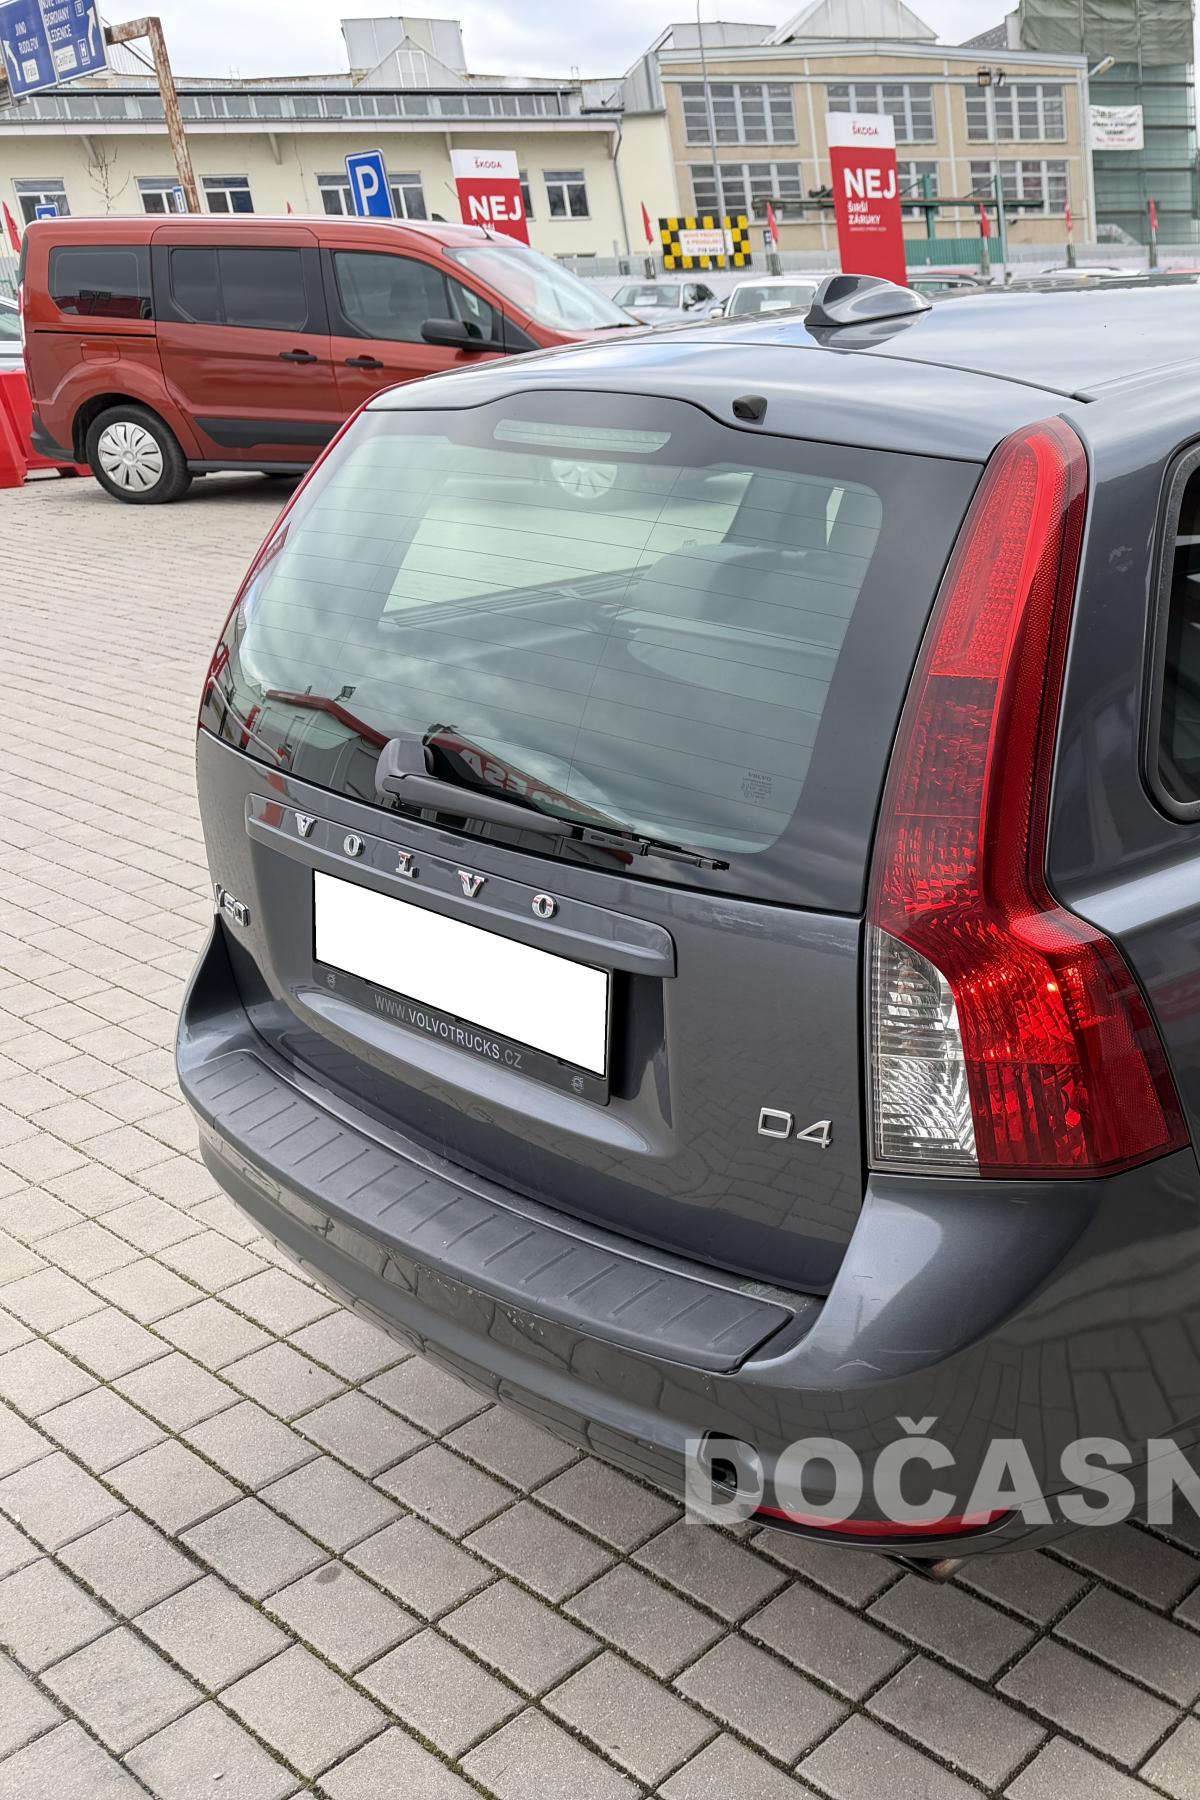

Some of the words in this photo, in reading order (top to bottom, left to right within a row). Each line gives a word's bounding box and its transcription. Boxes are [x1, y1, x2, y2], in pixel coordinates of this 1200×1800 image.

[852, 125, 879, 135] ŠKODA
[474, 157, 502, 169] ŠKODA
[355, 165, 379, 216] P
[843, 167, 897, 199] NEJ
[468, 195, 522, 221] NEJ
[295, 812, 559, 918] VOLVO
[374, 993, 523, 1069] WWW.VOLVOTRUCKS.CZ
[757, 1106, 832, 1149] D4
